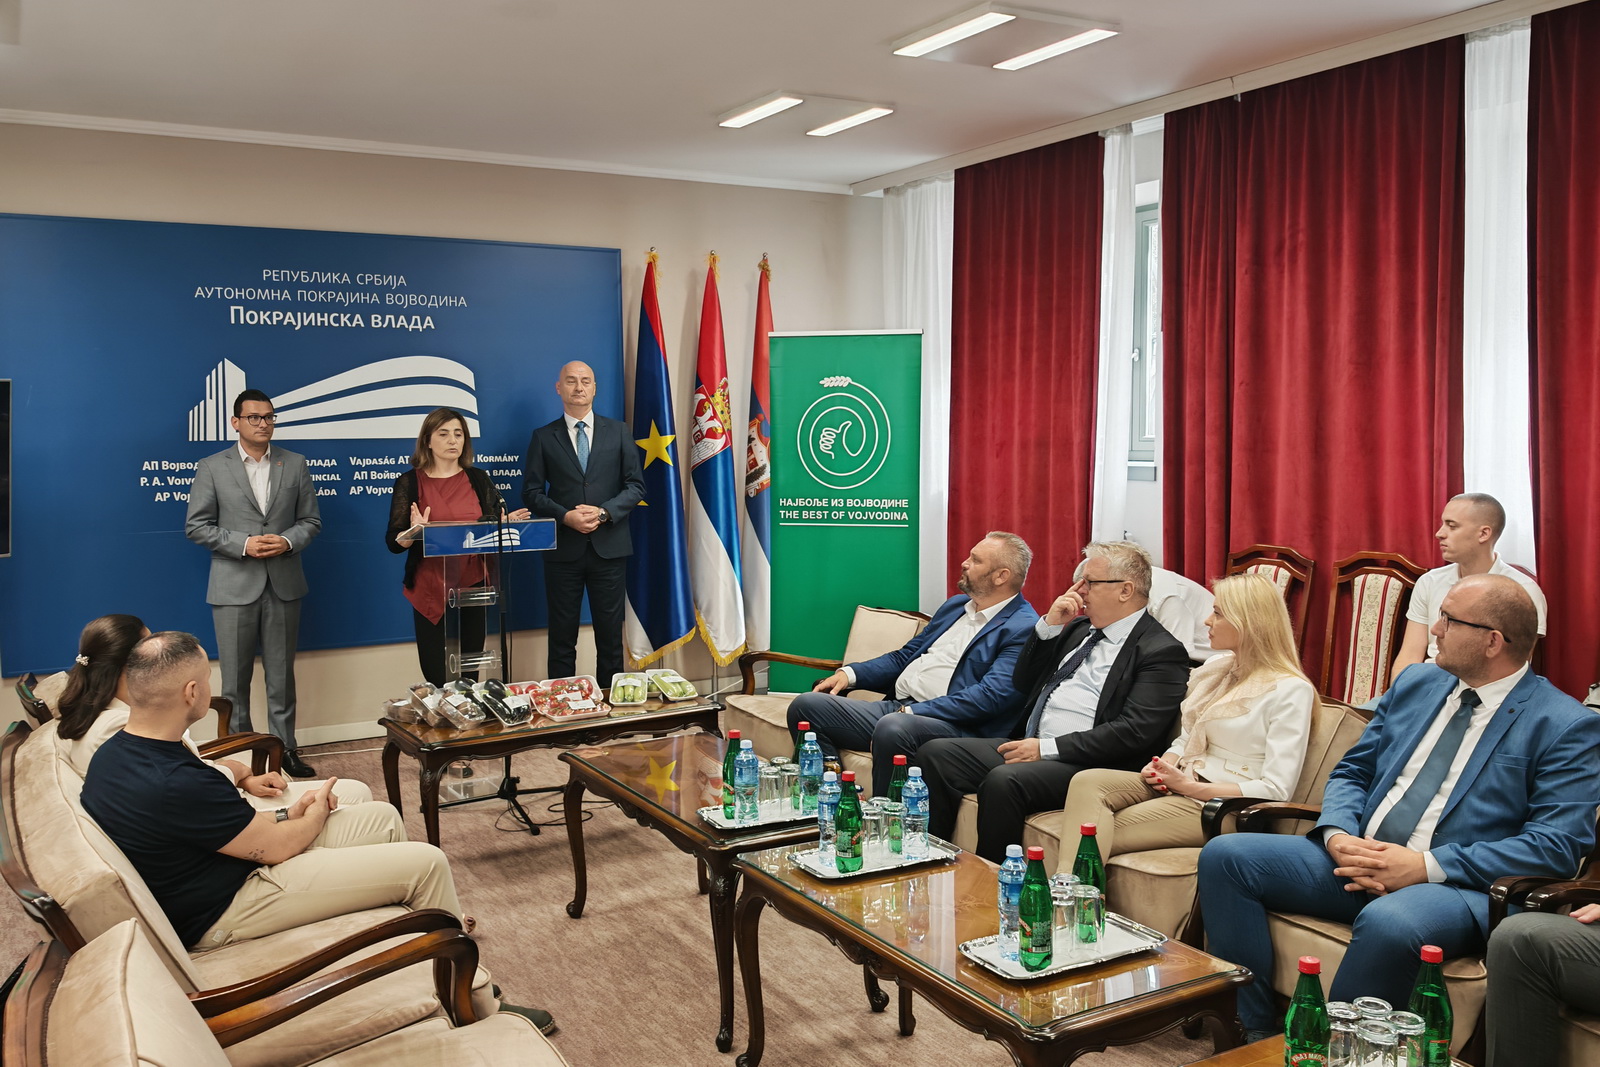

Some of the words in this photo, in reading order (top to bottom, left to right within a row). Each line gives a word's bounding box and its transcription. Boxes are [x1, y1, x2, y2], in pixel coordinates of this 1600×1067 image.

[262, 269, 351, 284] РЕПУБЛИКА
[356, 273, 407, 290] СРБИЈА
[194, 286, 292, 301] АУТОНОМНА
[297, 289, 380, 307] ПОКРАЈИНА
[385, 293, 468, 309] ВОЈВОДИНА
[370, 314, 436, 332] ВЛАДА
[397, 455, 411, 465] AT
[142, 461, 159, 471] АП
[353, 471, 368, 480] АП
[140, 477, 150, 487] P.
[152, 476, 165, 486] A.
[349, 486, 364, 495] AP
[154, 492, 171, 502] AP
[779, 498, 829, 507] НАЈБОЉЕ
[831, 499, 844, 507] ИЗ
[846, 499, 909, 509] ВОЈВОДИНЕ
[779, 510, 800, 519] THE
[802, 511, 829, 519] BEST
[831, 511, 846, 520] OF
[847, 511, 909, 520] VOJVODINA
